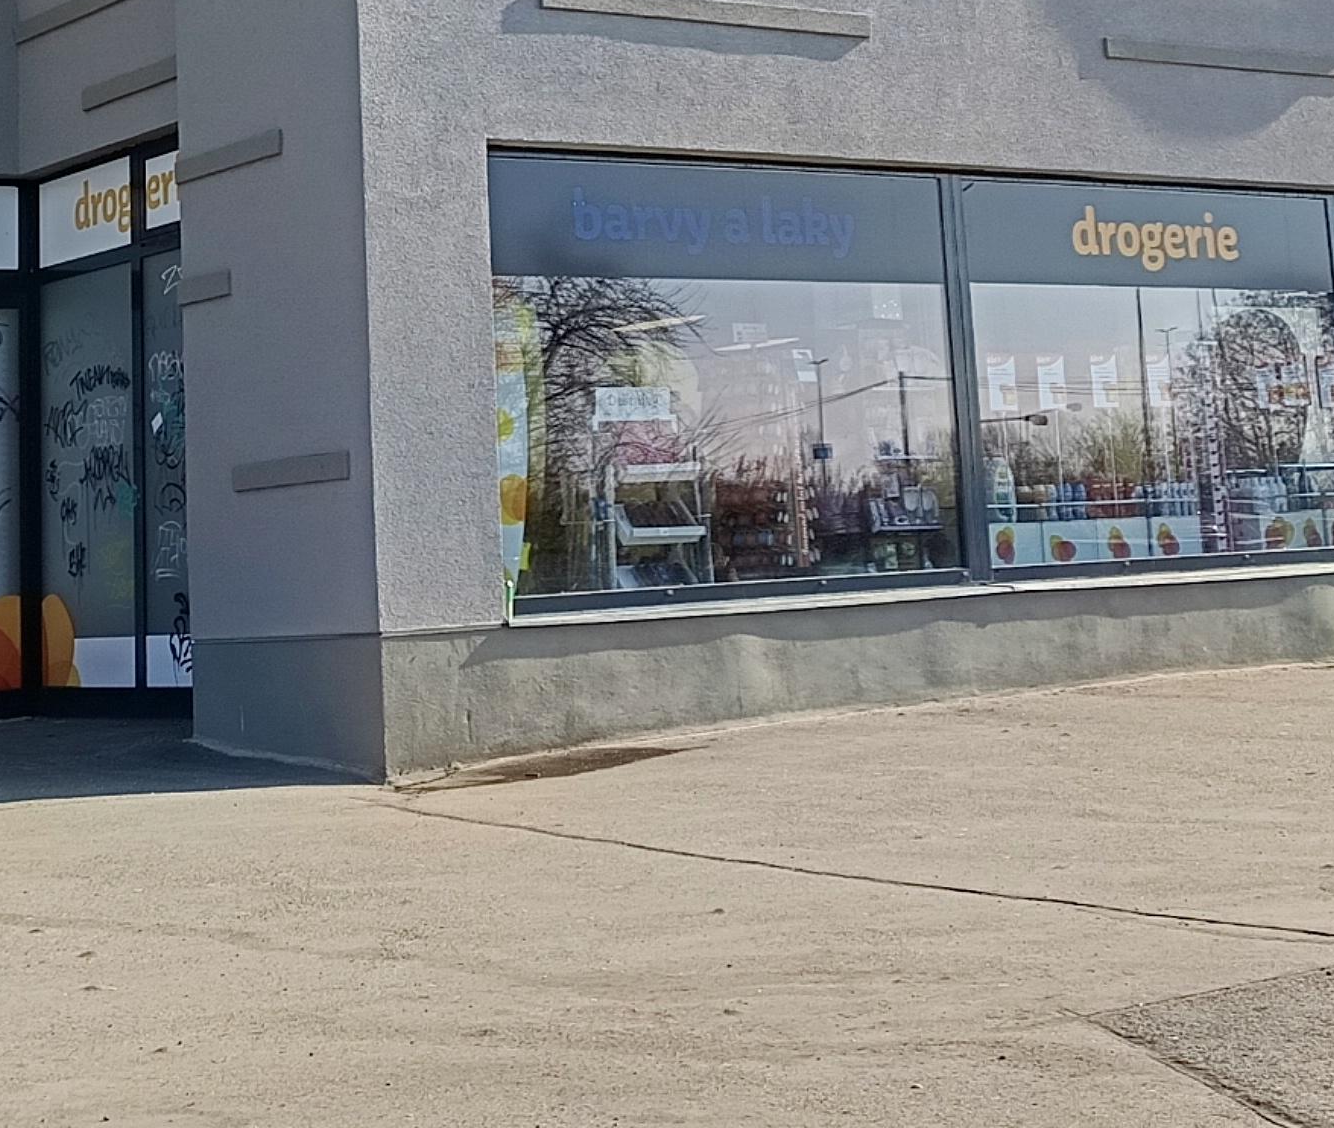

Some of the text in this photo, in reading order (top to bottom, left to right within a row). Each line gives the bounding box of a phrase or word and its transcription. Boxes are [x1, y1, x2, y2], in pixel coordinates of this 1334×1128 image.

[573, 186, 857, 259] barvy a laky
[1072, 205, 1240, 271] drogerie
